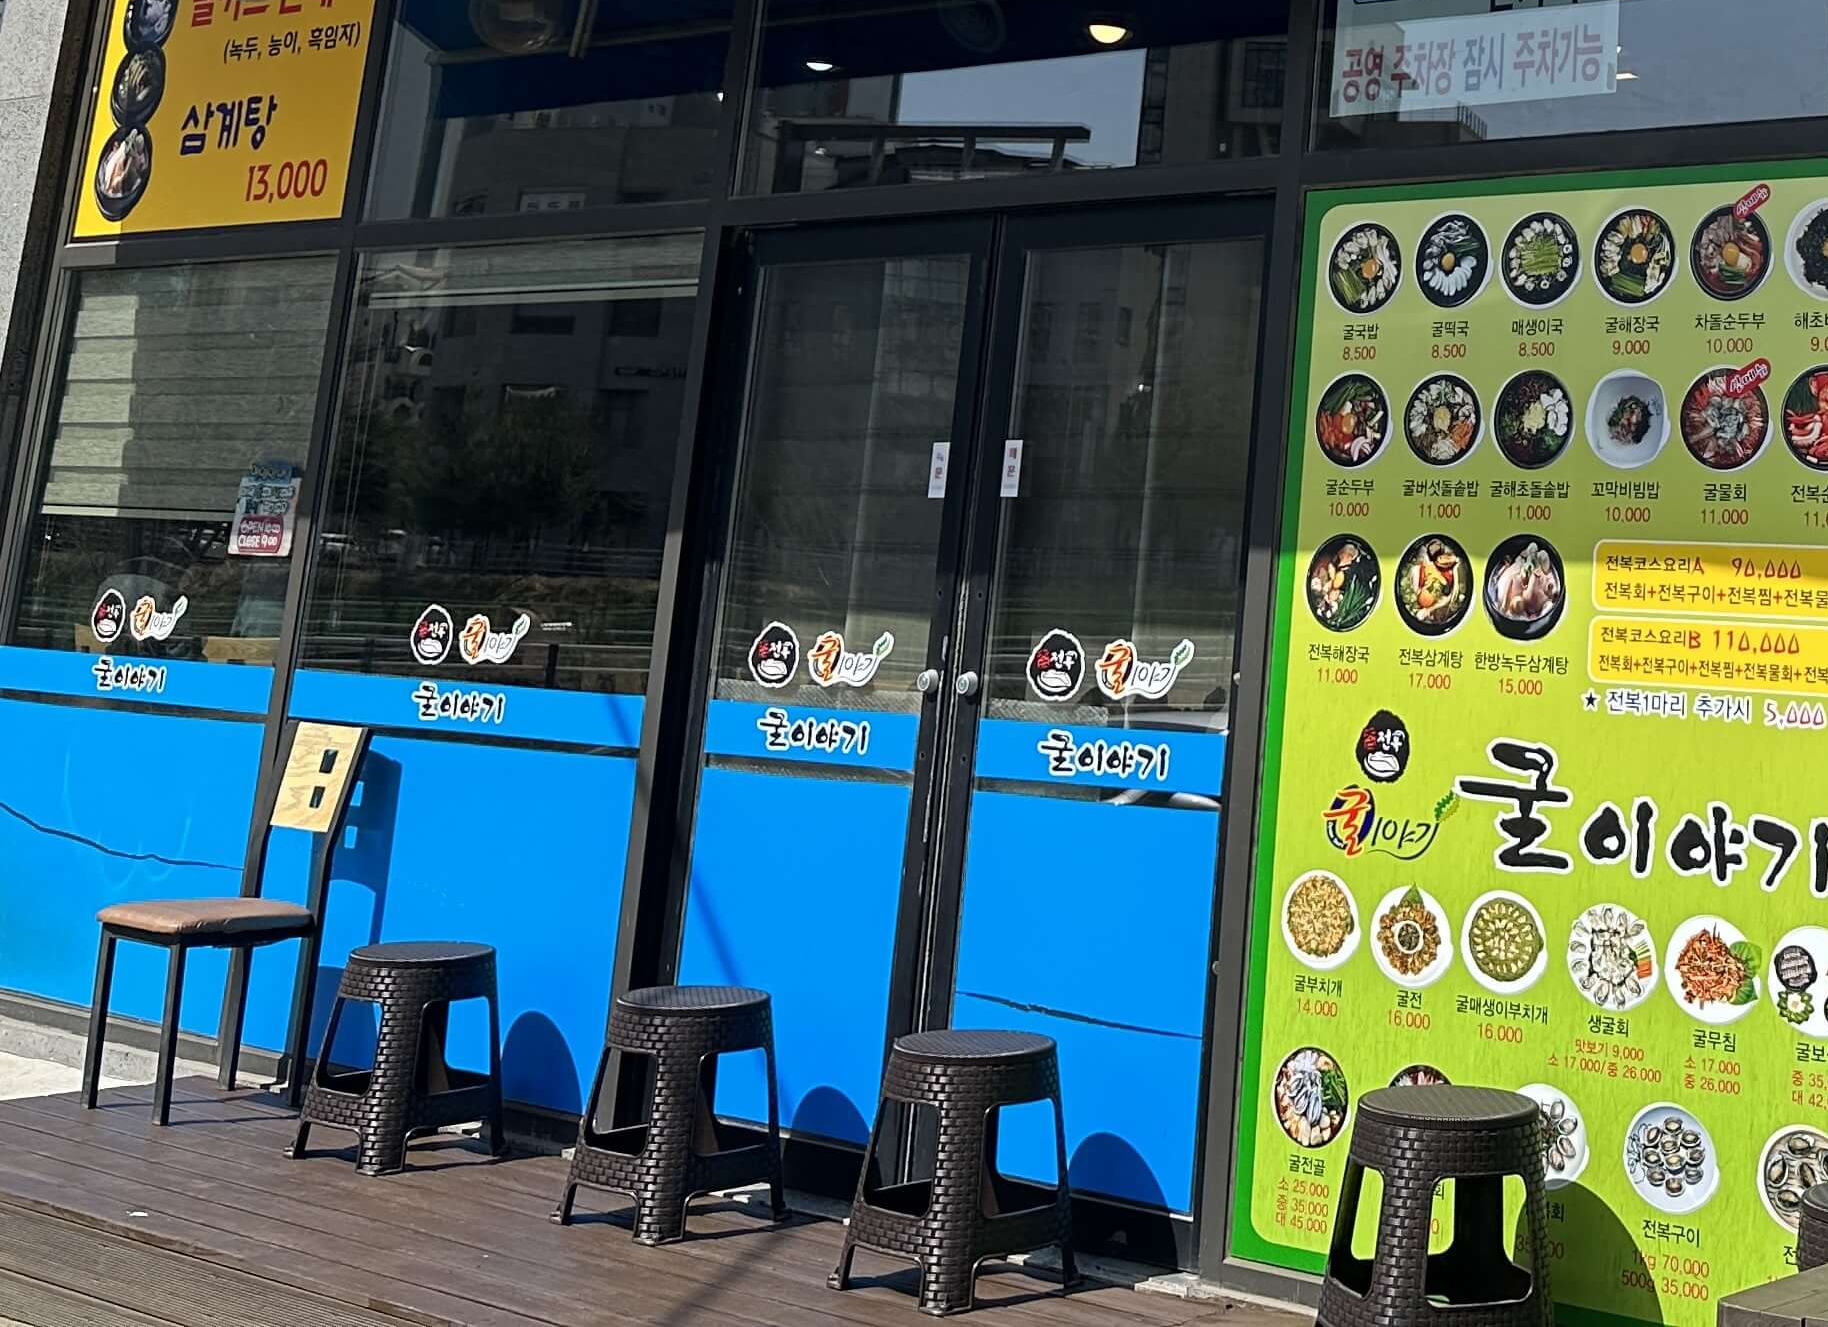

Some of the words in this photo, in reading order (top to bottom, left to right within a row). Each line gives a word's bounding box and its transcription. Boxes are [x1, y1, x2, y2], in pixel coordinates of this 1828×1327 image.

[1342, 44, 1384, 102] 공영
[1390, 39, 1456, 97] 주차장
[1463, 33, 1505, 92] 잠시
[1513, 25, 1603, 88] 주차가능
[180, 94, 278, 155] 삼계탕
[246, 158, 327, 203] 13,000
[1343, 323, 1379, 341] 굴국밥
[1432, 320, 1469, 338] 굴떡국
[1511, 318, 1564, 337] 매생이국
[1604, 315, 1660, 334] 굴해장국
[1695, 312, 1766, 331] 차돌순두부
[1325, 478, 1375, 497] 굴순두부
[1703, 483, 1747, 502] 굴물회
[1308, 643, 1370, 665] 전복해장국
[1399, 648, 1464, 669] 전복삼계탕
[1474, 651, 1569, 675] 한방녹두삼계탕
[94, 659, 165, 690] 굴이야기
[414, 685, 504, 720] 굴이야기
[1607, 691, 1686, 716] 전복1마리
[1696, 695, 1750, 722] 추가시
[760, 712, 868, 752] 굴이야기
[1040, 733, 1168, 777] 굴이야기
[1397, 989, 1423, 1010] 굴전
[1588, 1014, 1631, 1038] 생굴회
[1575, 1039, 1609, 1057] 맛보기
[1692, 1029, 1738, 1053] 굴무침
[1547, 1053, 1559, 1067] 소
[1683, 1055, 1697, 1069] 소
[1683, 1073, 1696, 1090] 중
[1791, 1069, 1803, 1087] 중
[1791, 1089, 1803, 1106] 대
[1289, 1154, 1326, 1178] 굴전골
[1642, 1219, 1700, 1248] 전복구이
